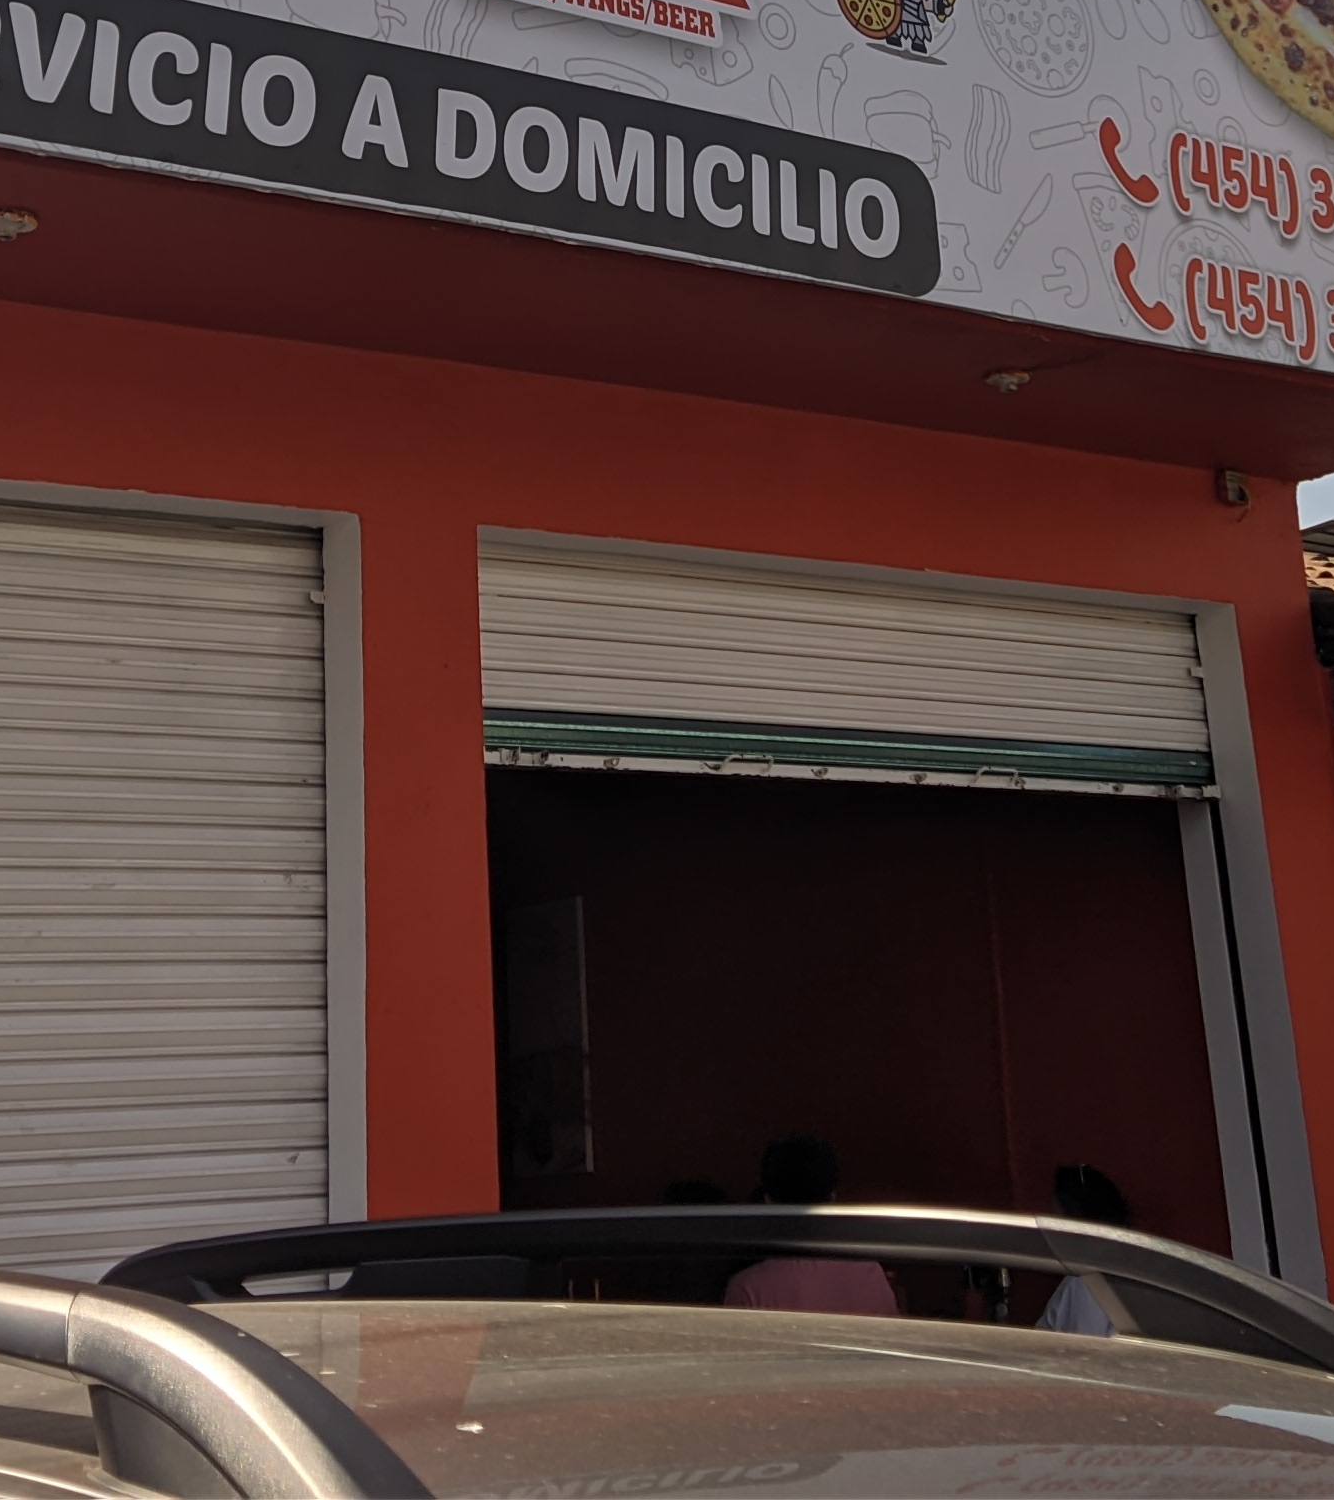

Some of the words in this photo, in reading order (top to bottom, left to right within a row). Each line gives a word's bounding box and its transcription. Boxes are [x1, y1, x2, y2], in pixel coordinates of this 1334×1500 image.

[341, 74, 409, 169] A
[435, 87, 901, 259] DOMICILIO
[1169, 131, 1301, 240] (454)
[1185, 257, 1317, 363] (454)
